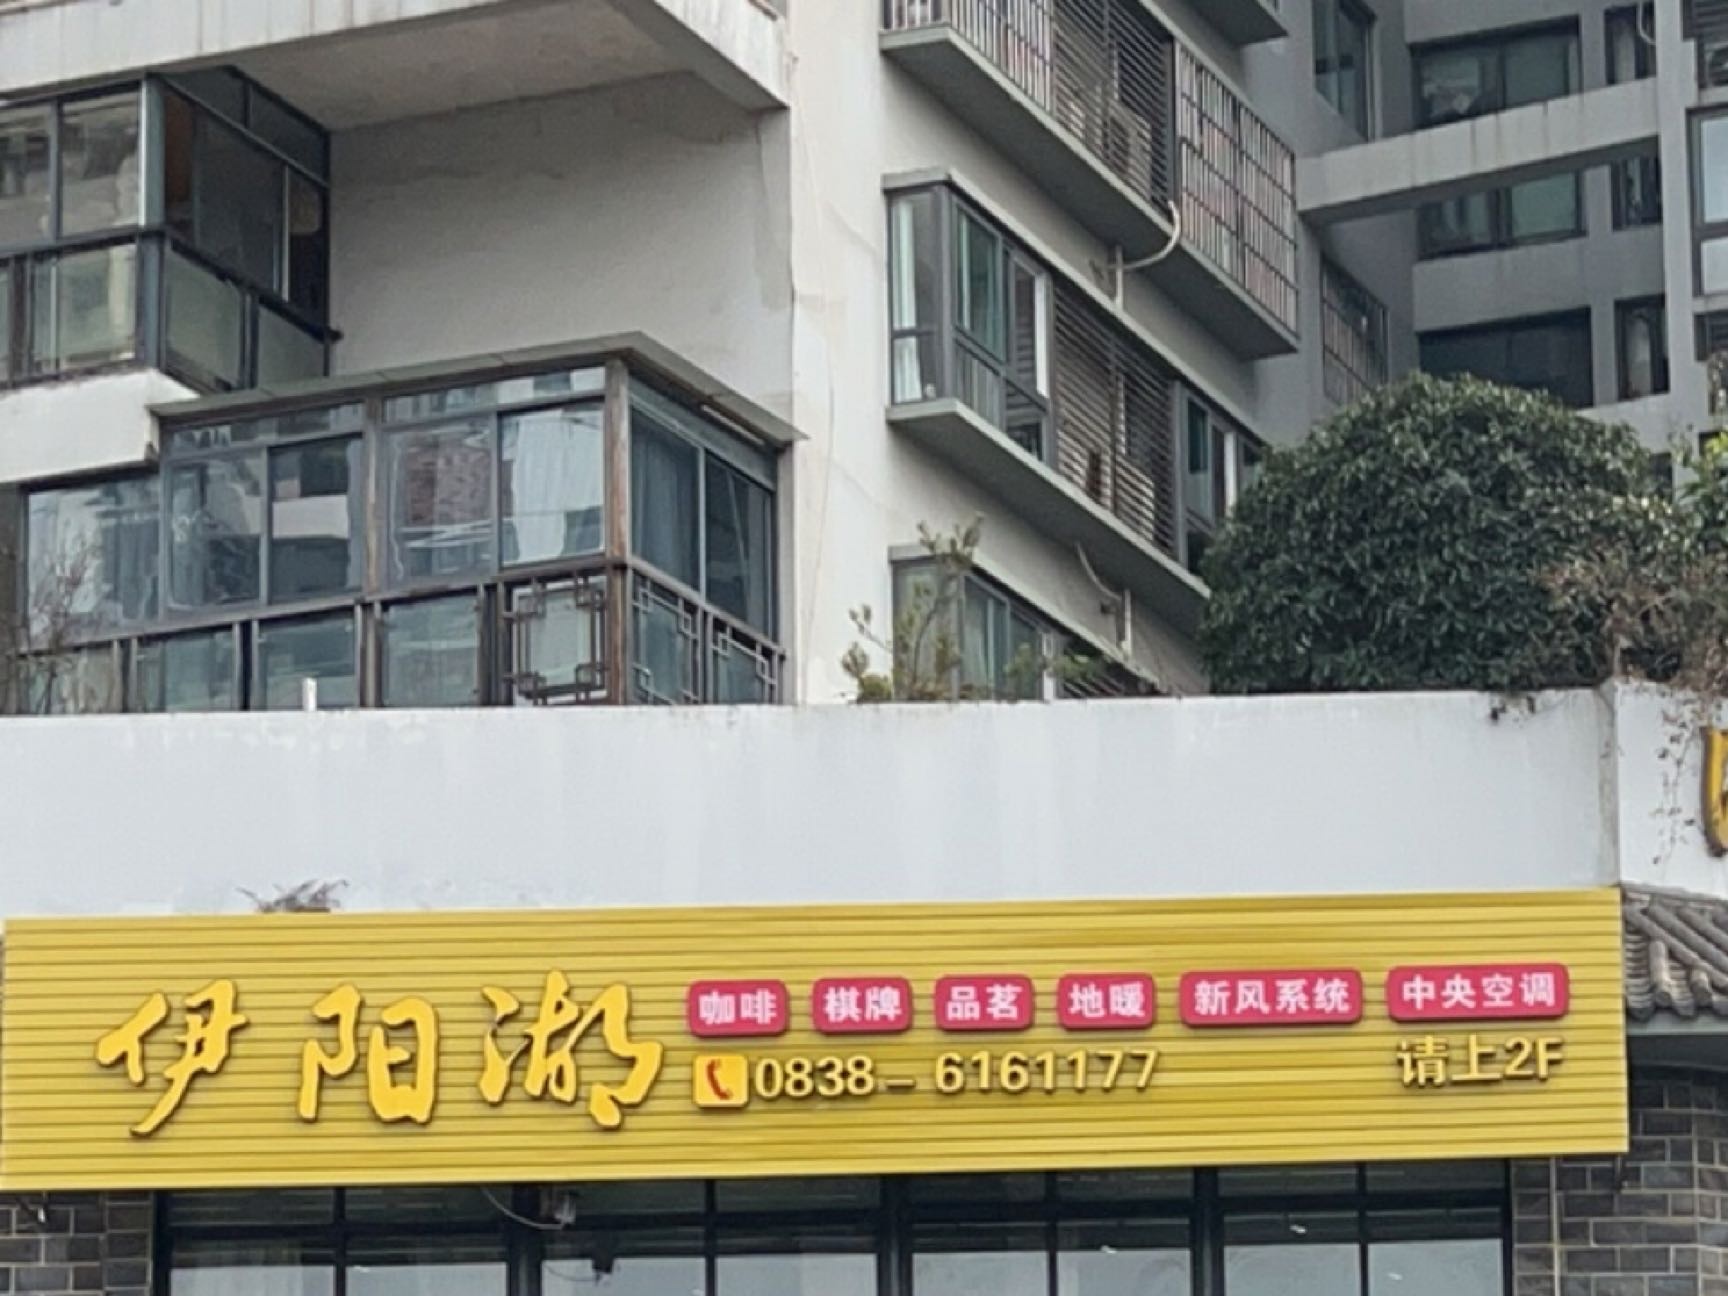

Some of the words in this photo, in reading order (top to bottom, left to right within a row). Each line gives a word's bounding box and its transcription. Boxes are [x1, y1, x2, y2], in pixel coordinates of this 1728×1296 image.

[698, 988, 778, 1025] 咖啡
[823, 985, 902, 1022] 棋牌
[946, 983, 1022, 1021] 品茗
[1068, 981, 1147, 1019] 地暖
[1193, 977, 1351, 1016] 新风系统
[1401, 971, 1558, 1011] 中央空调
[1397, 1033, 1566, 1087] 请上2F
